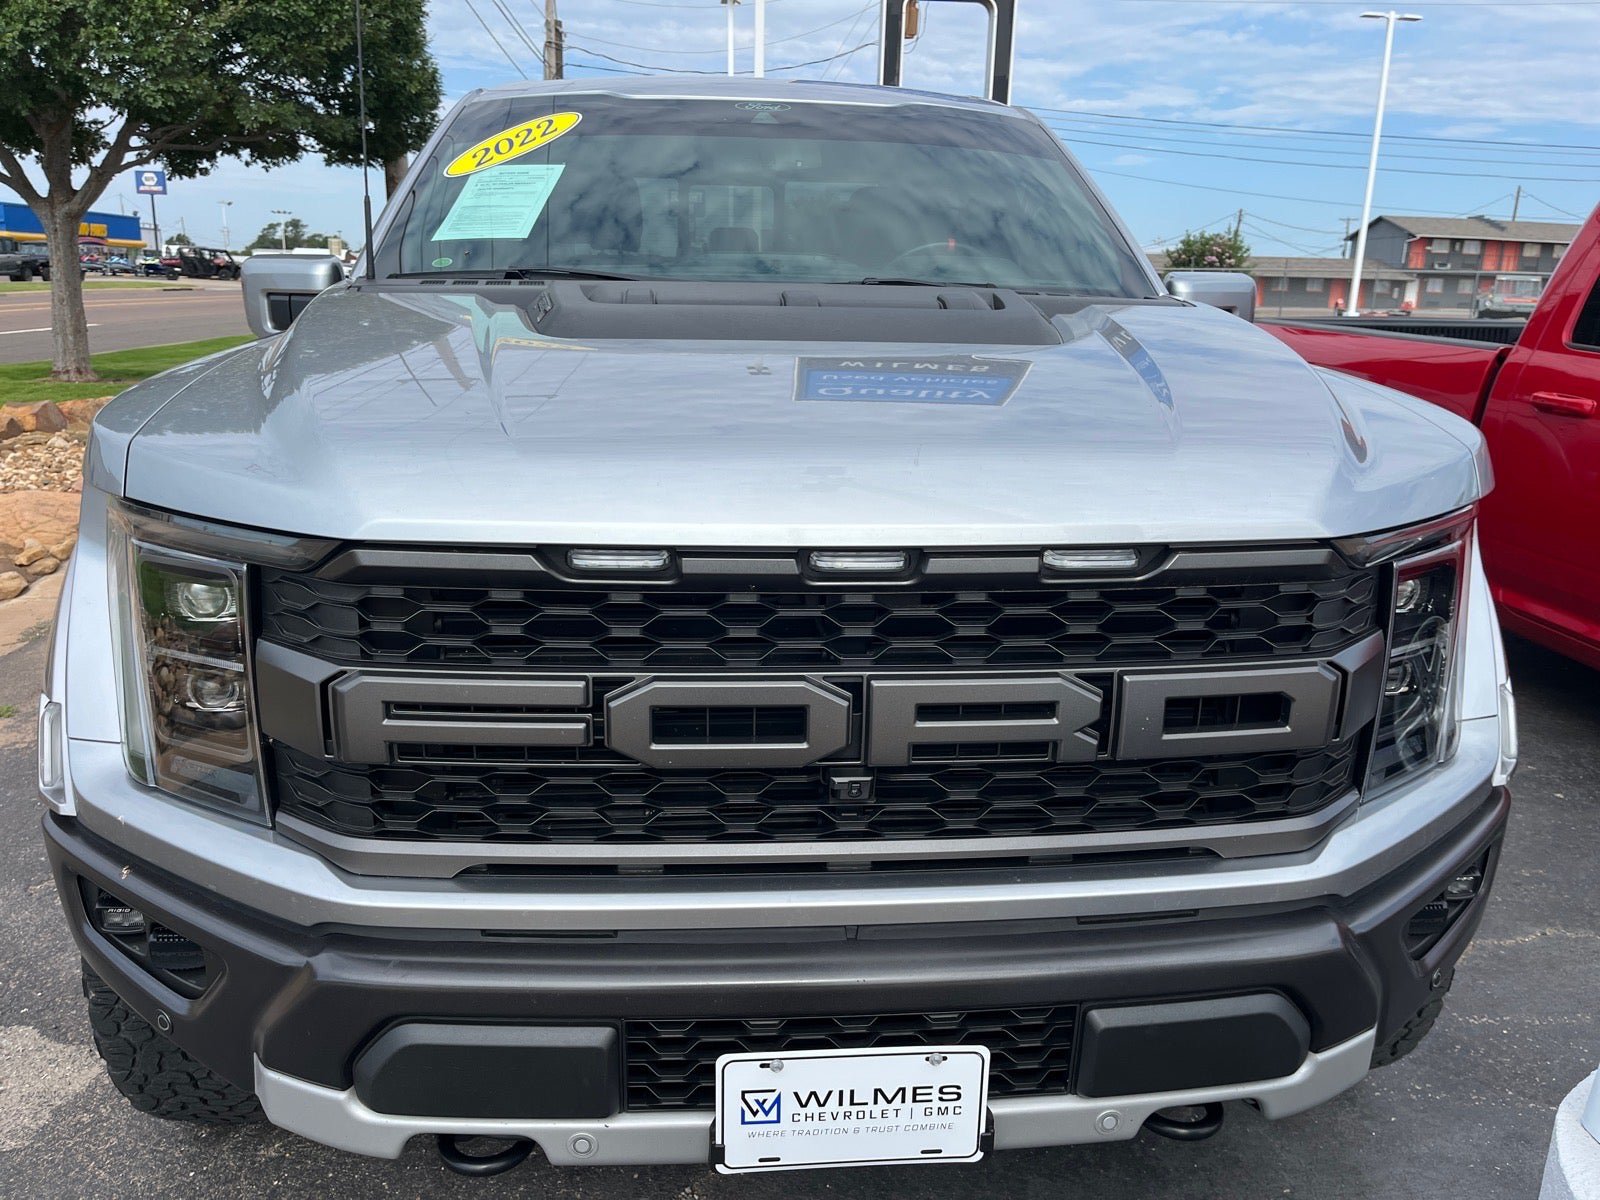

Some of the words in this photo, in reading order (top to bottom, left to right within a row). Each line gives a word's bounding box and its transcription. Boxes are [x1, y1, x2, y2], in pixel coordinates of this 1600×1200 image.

[472, 118, 559, 168] 2022
[331, 664, 1341, 769] FORD
[793, 1085, 963, 1108] WILMES
[791, 1108, 902, 1123] CHEVROLET
[923, 1105, 963, 1117] GMC
[747, 1129, 787, 1139] WHERE
[791, 1127, 849, 1137] TRADITION
[865, 1124, 900, 1134] TRUST
[904, 1122, 955, 1132] COMBINE
